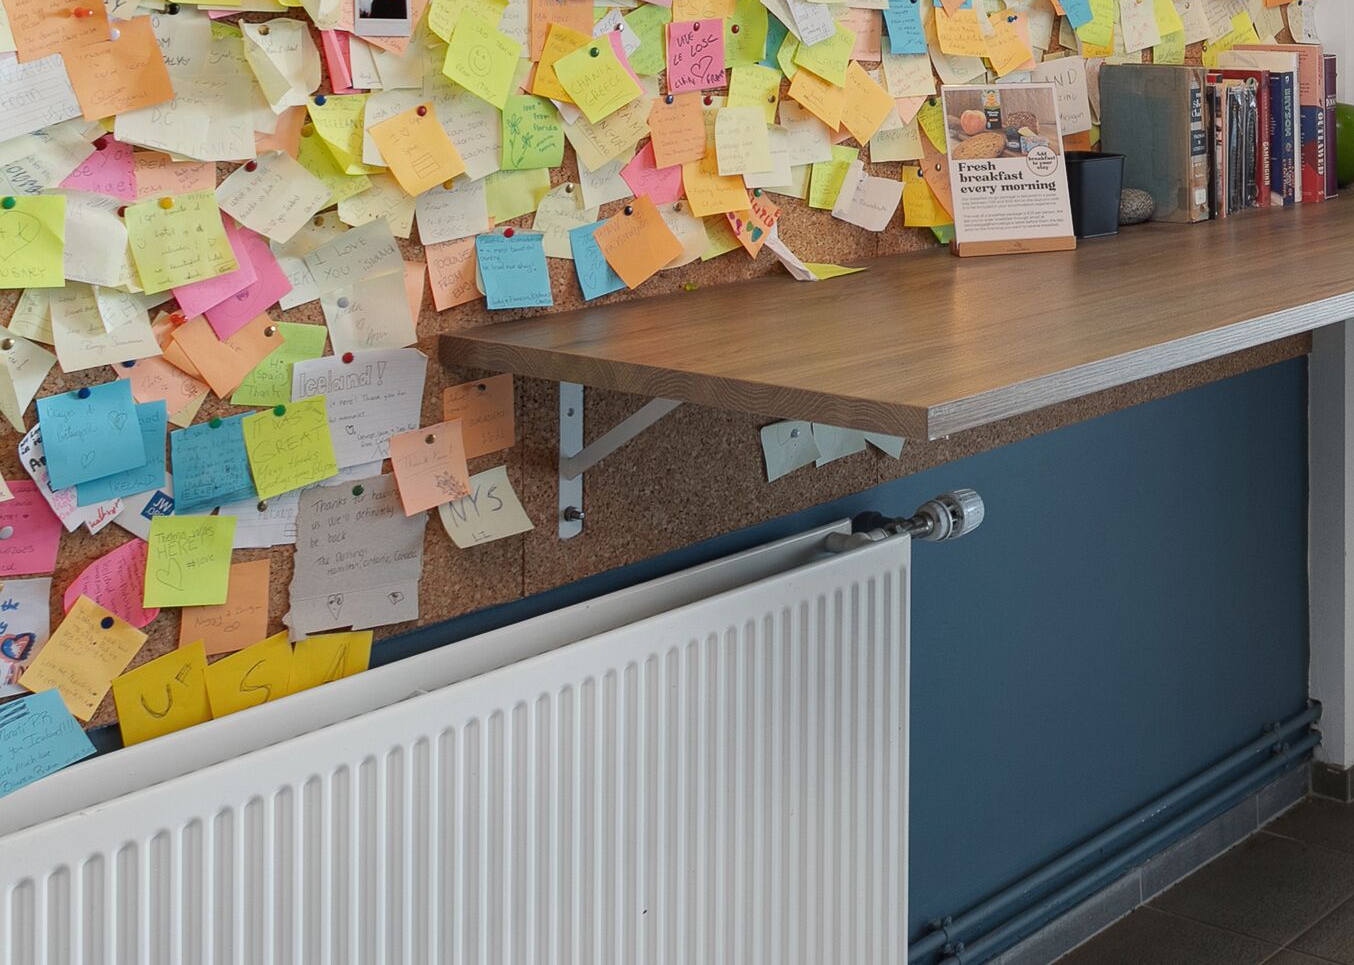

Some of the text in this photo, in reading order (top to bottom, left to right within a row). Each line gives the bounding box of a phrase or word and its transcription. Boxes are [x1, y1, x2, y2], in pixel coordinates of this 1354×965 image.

[673, 52, 683, 66] LE
[570, 65, 614, 94] CHANIA
[586, 73, 626, 106] GREECE
[1317, 111, 1325, 176] OUTLAWED
[958, 161, 997, 173] Fresh
[959, 170, 1024, 183] breakfast
[960, 179, 1057, 195] every morning
[335, 237, 369, 259] LOVE
[322, 265, 352, 281] YOU
[272, 412, 302, 430] WAS
[251, 424, 325, 464] GREAT
[153, 497, 174, 514] JW
[310, 497, 347, 513] Thanks
[351, 494, 366, 505] for
[448, 481, 505, 524] NYS
[309, 531, 347, 549] be back
[155, 540, 198, 560] HERE
